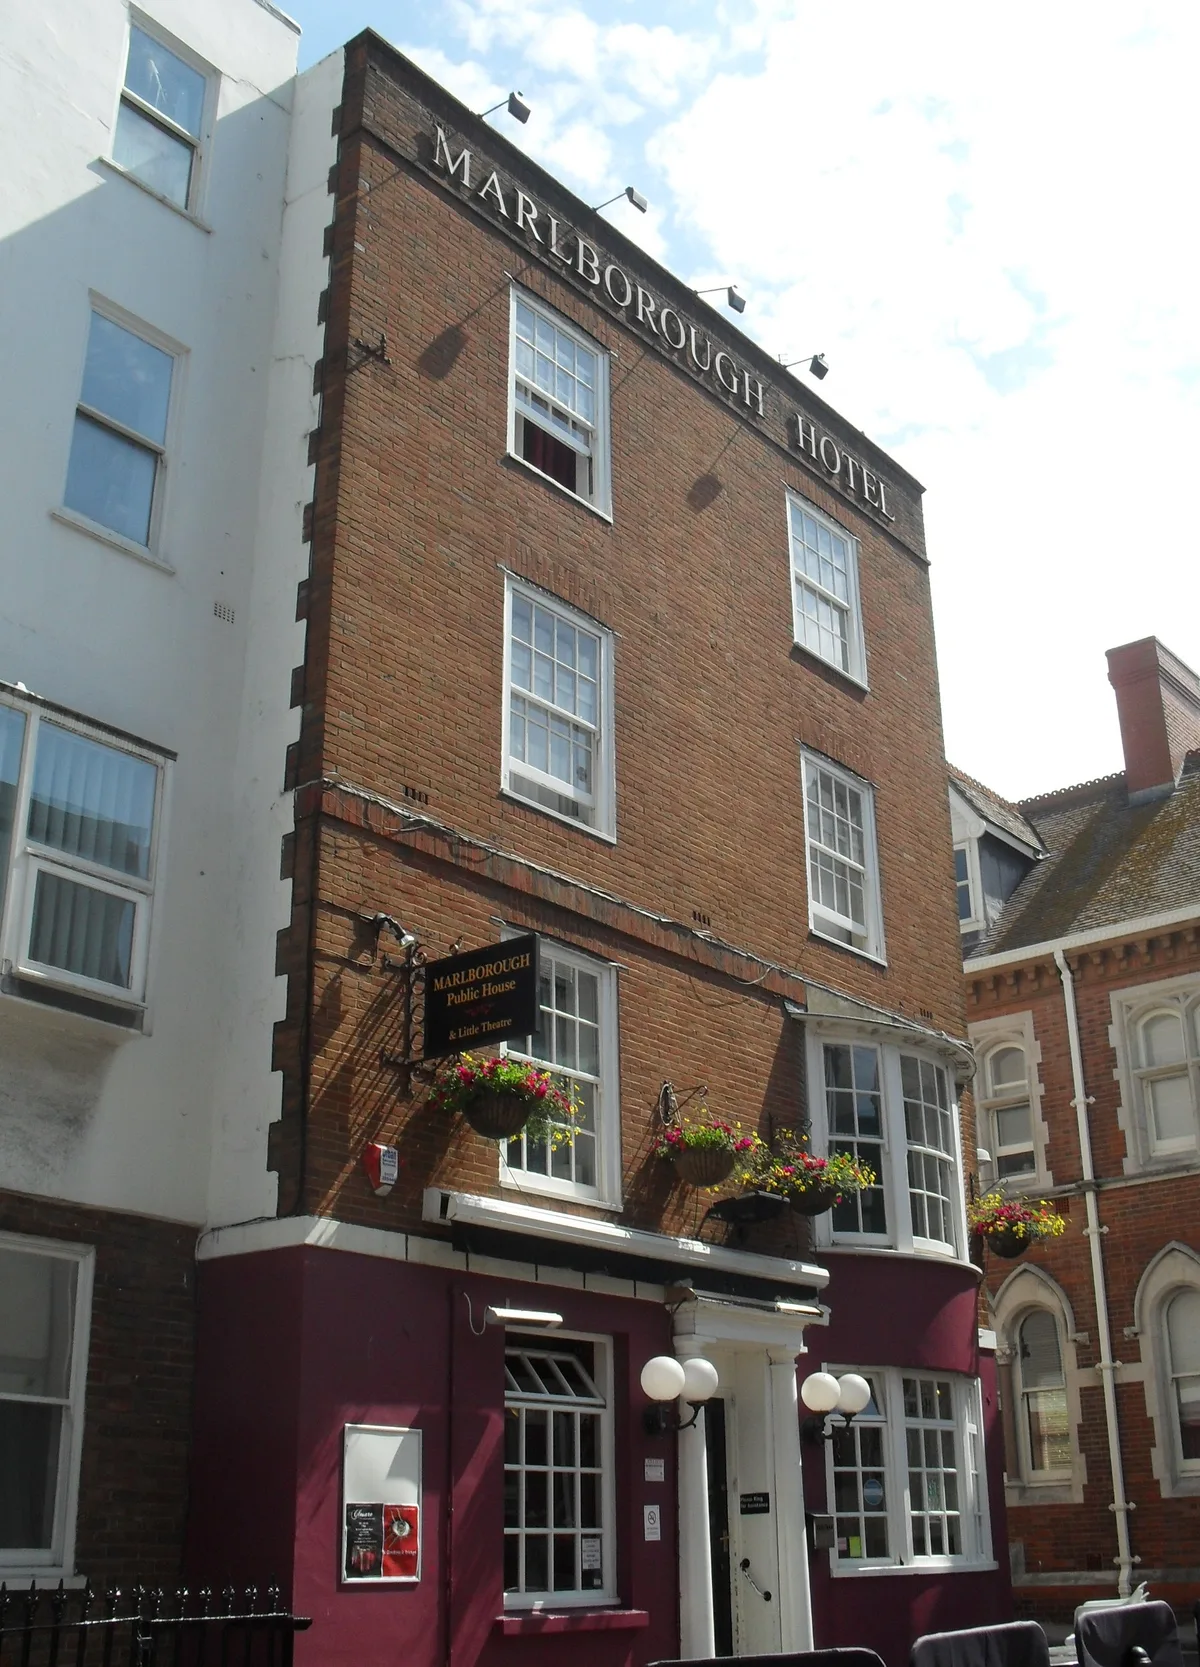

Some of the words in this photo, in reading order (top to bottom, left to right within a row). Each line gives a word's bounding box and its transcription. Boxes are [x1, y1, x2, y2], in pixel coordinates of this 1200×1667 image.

[433, 125, 766, 419] MARLBOROUGH
[795, 413, 895, 521] HOTEL
[433, 953, 531, 991] MARLBOROUGH
[446, 986, 480, 1006] Public
[482, 980, 516, 997] House
[449, 1030, 457, 1040] &
[458, 1024, 480, 1038] Little
[481, 1018, 512, 1032] Theatre
